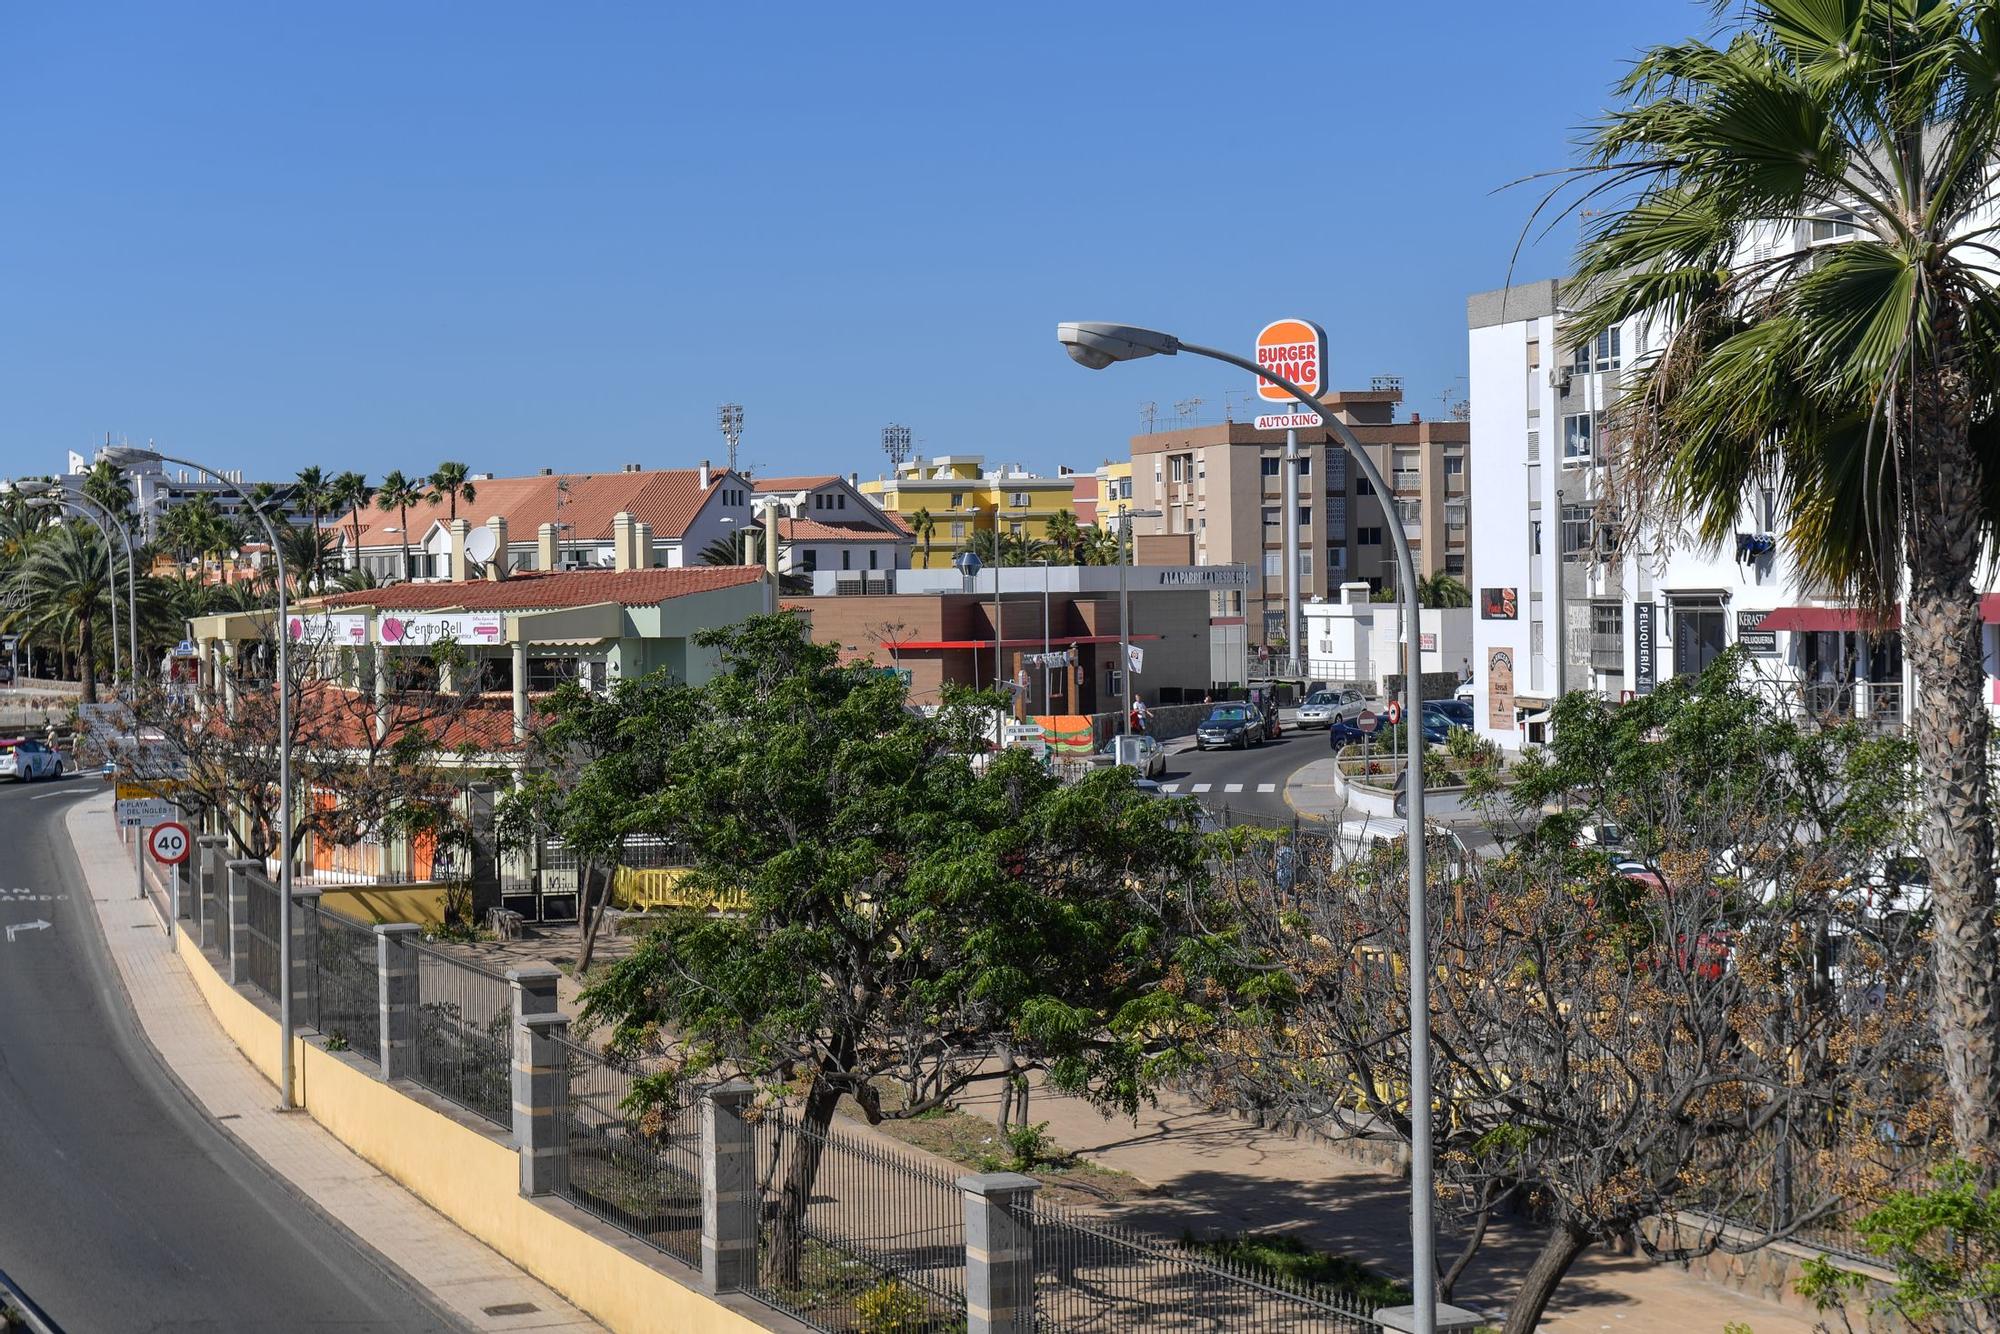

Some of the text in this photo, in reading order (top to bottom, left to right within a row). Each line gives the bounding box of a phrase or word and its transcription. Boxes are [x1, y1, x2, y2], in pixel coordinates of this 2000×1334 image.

[1259, 345, 1316, 363] BURGER
[1259, 414, 1318, 428] AUTO KING
[1639, 606, 1650, 674] PELUQUERÍA
[142, 806, 167, 814] INGLÉS
[158, 836, 182, 850] 40
